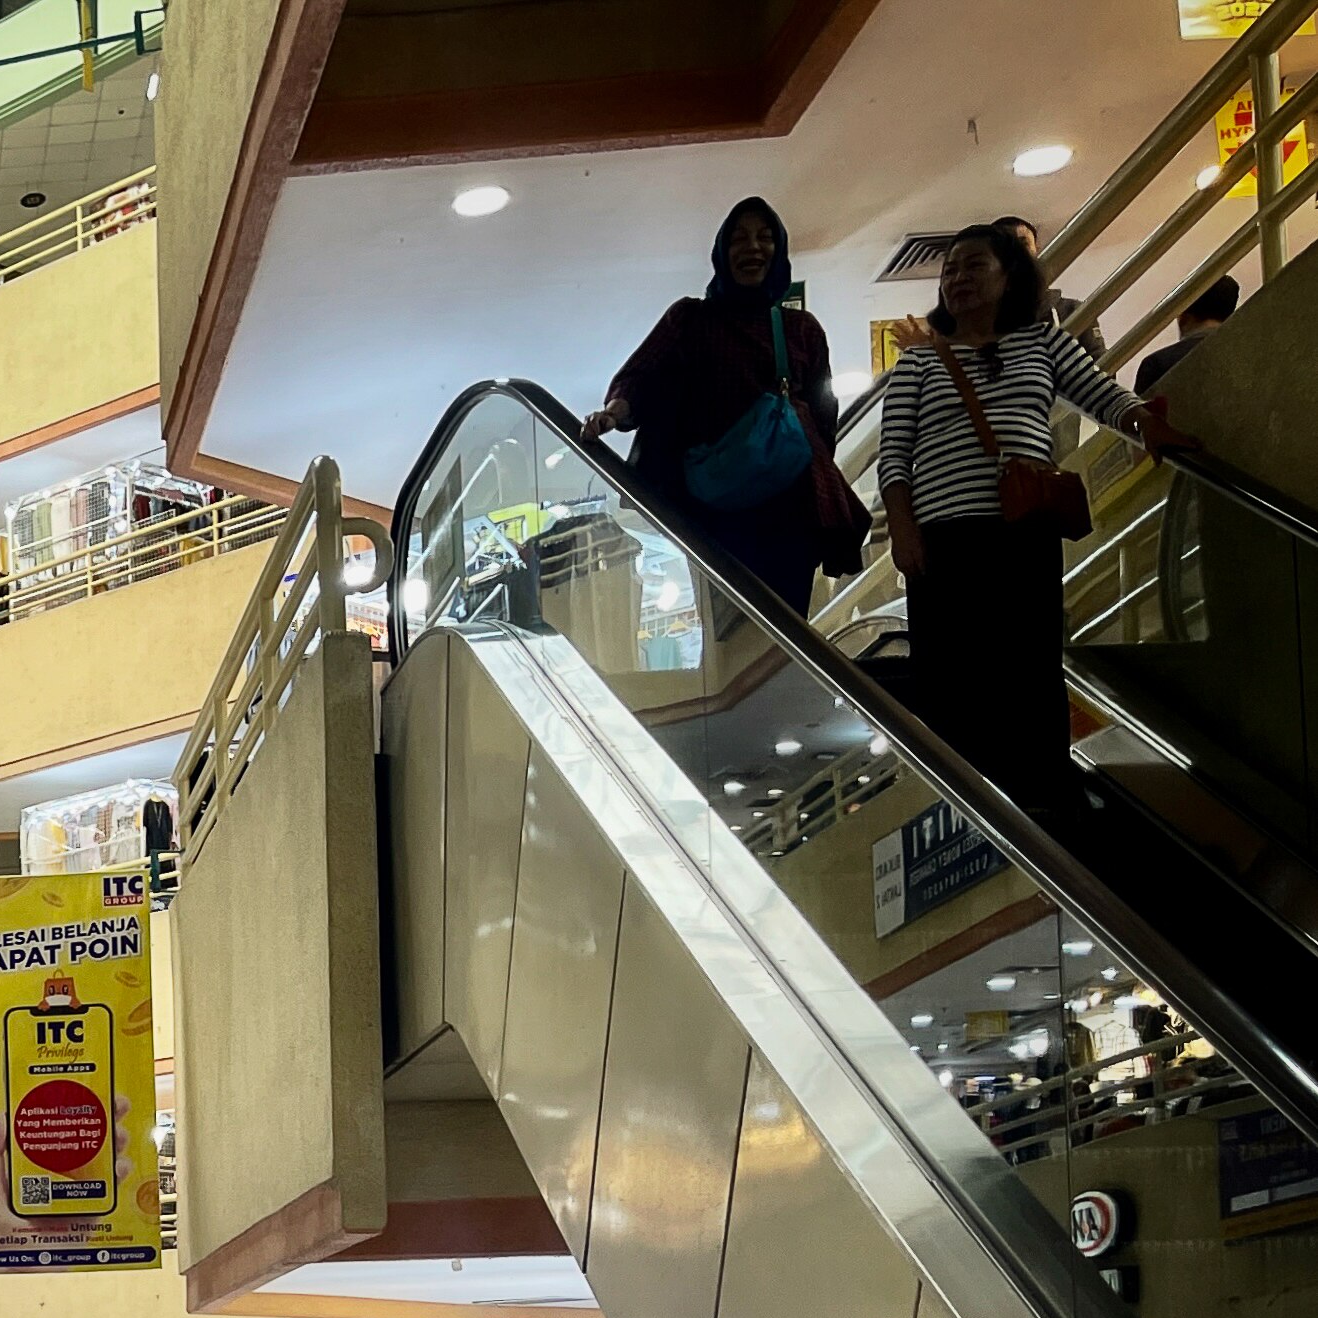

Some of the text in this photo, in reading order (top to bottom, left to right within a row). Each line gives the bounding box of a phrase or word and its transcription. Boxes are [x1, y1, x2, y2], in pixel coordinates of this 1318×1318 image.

[103, 875, 143, 896] ITC
[104, 895, 144, 905] GROUP
[51, 916, 139, 941] BELANJA
[70, 933, 138, 962] POIN
[37, 1020, 84, 1044] ITC
[67, 1065, 90, 1073] Apps
[20, 1106, 59, 1117] Aplikasi
[16, 1118, 101, 1129] Yang Memberikan
[19, 1129, 101, 1140] Keuntungan Bagi
[22, 1140, 99, 1152] Pengunjung ITC
[52, 1182, 102, 1191] DOWNLOAD
[66, 1190, 88, 1198] NOW
[70, 1223, 112, 1233] Untung
[31, 1233, 84, 1244] Transaksi
[8, 1254, 19, 1263] Us
